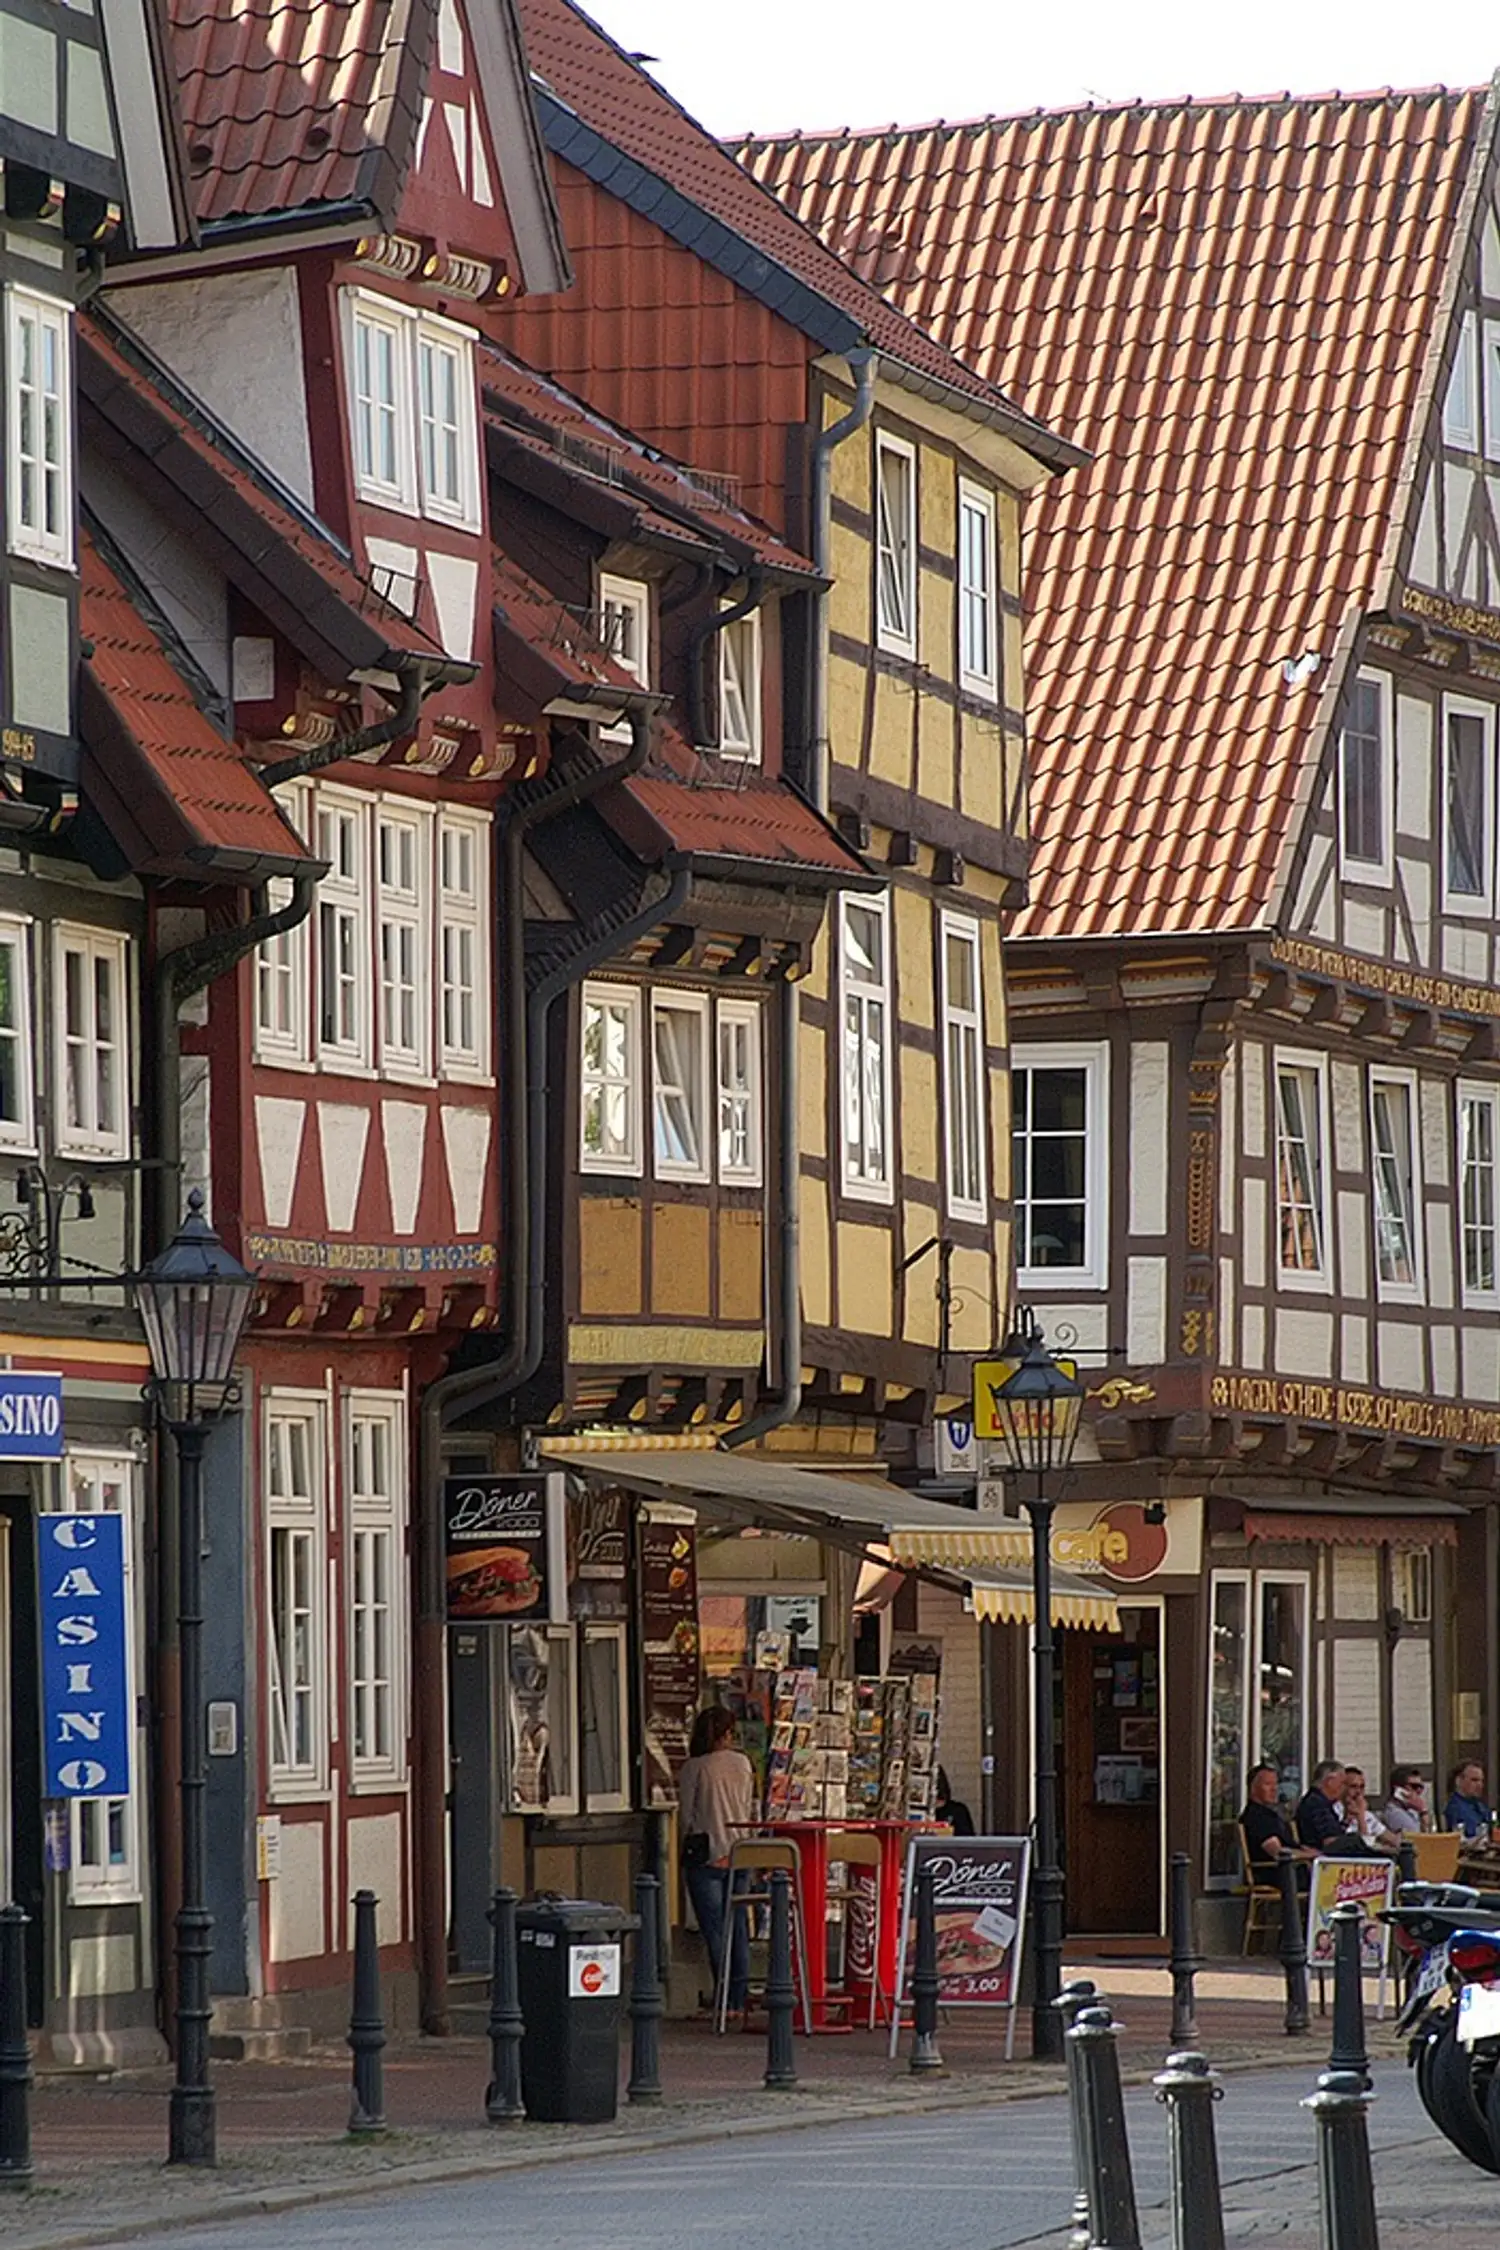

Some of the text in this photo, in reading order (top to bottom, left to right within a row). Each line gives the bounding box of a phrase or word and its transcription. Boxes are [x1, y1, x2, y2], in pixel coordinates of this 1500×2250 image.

[0, 1393, 60, 1436] SINO
[448, 1487, 537, 1530] Döner
[52, 1518, 107, 1790] CASINO
[924, 1856, 1013, 1892] Döner
